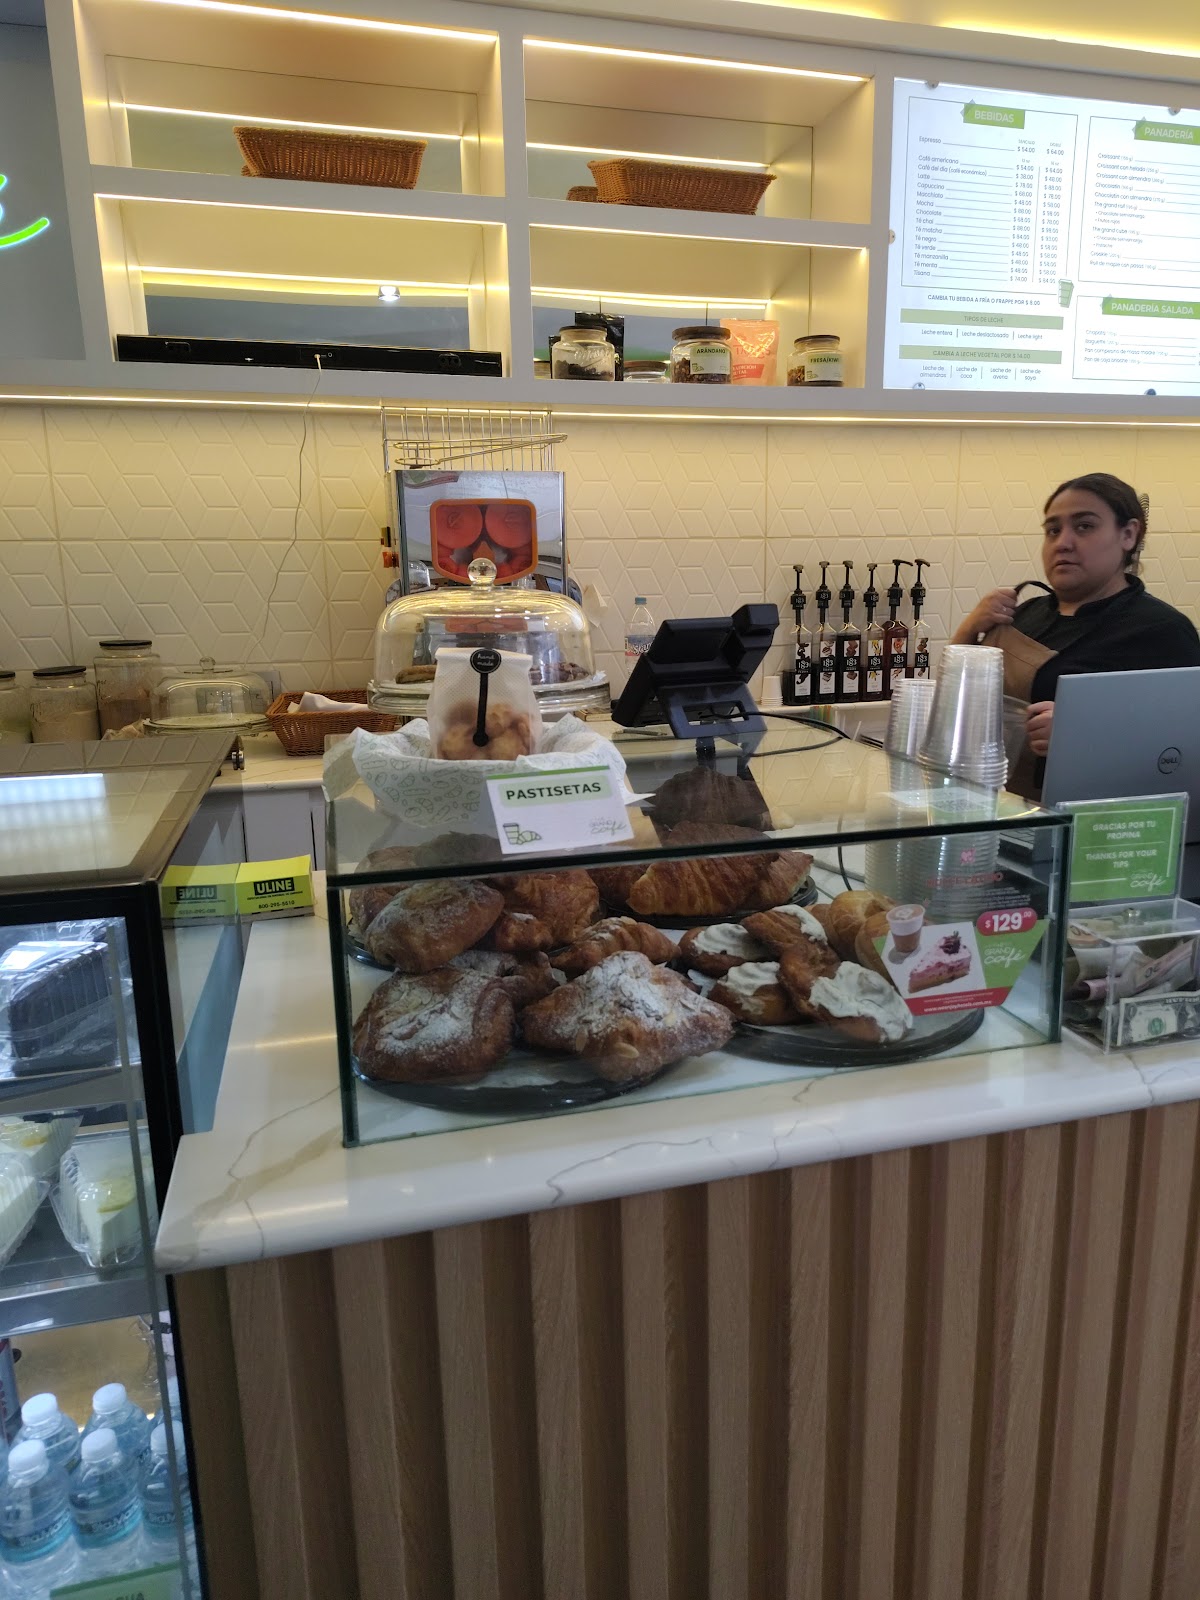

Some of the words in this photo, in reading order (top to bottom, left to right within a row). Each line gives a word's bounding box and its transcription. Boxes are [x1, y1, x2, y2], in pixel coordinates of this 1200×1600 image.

[974, 110, 1014, 123] BEBIDAS
[1144, 127, 1194, 140] PANADERÍA
[917, 182, 944, 191] Capuccino
[1111, 302, 1159, 313] PANADERÍA
[1161, 305, 1194, 315] SALADA
[506, 783, 601, 800] PASTISETAS
[1093, 822, 1126, 831] GRACIAS
[1107, 830, 1140, 840] PROPINA
[1086, 851, 1116, 861] THANKS
[1119, 851, 1134, 859] FOR
[1113, 860, 1129, 868] TIPS
[257, 880, 292, 894] ULINE
